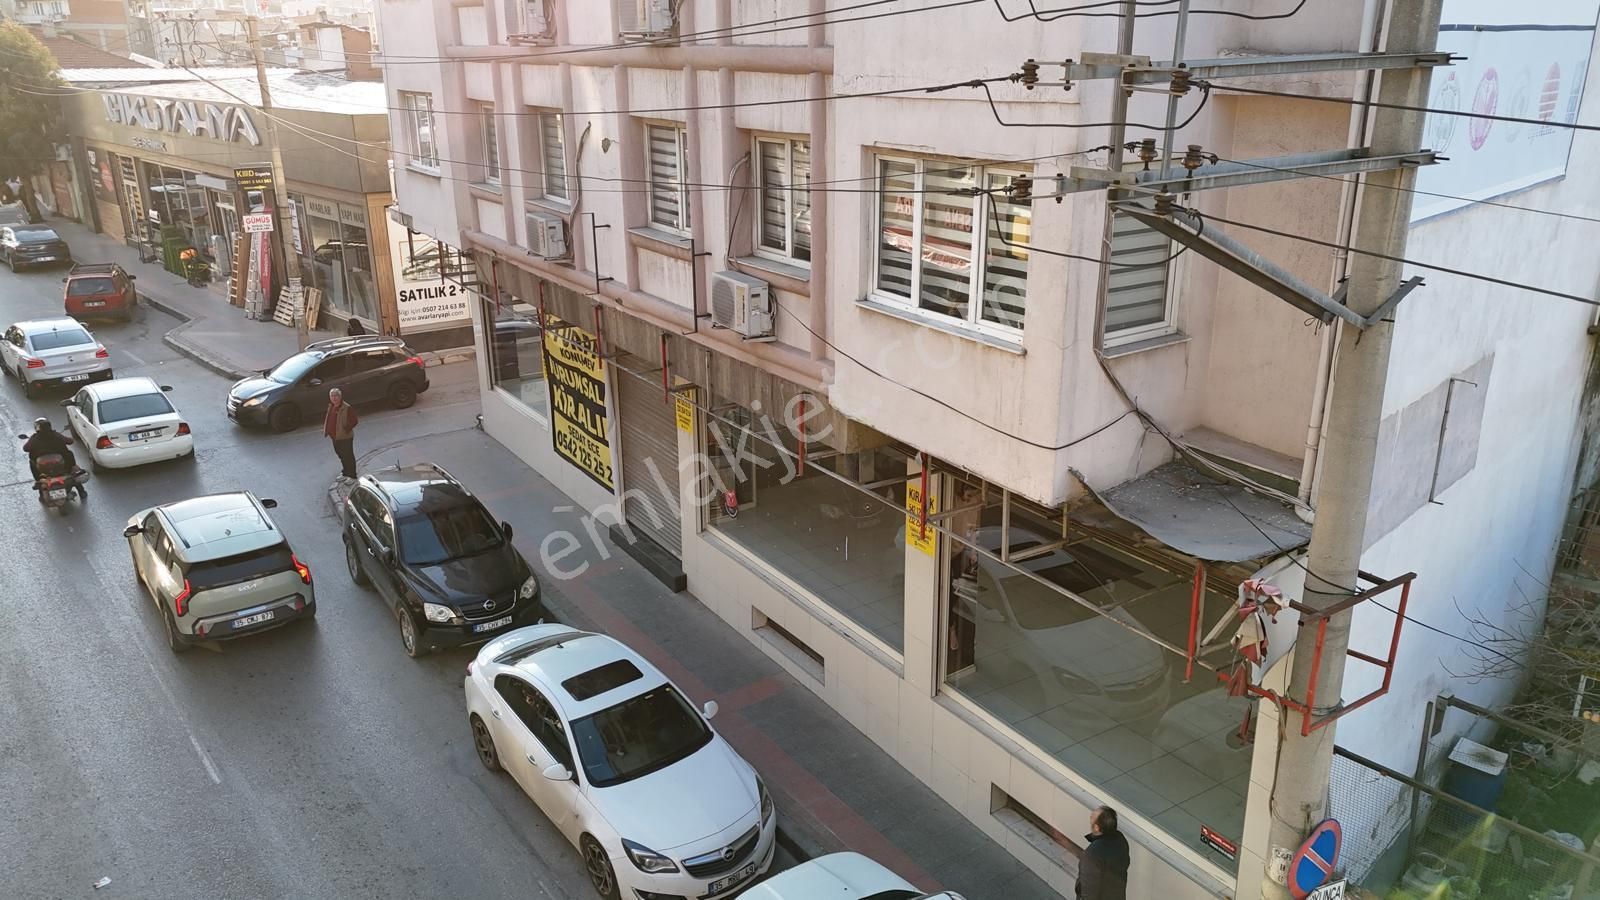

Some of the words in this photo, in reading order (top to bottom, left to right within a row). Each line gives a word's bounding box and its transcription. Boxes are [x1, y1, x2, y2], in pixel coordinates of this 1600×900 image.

[400, 286, 447, 302] SATILIK
[449, 285, 456, 296] 2
[557, 430, 577, 459] 0542
[579, 445, 592, 470] 125
[594, 457, 605, 478] 25
